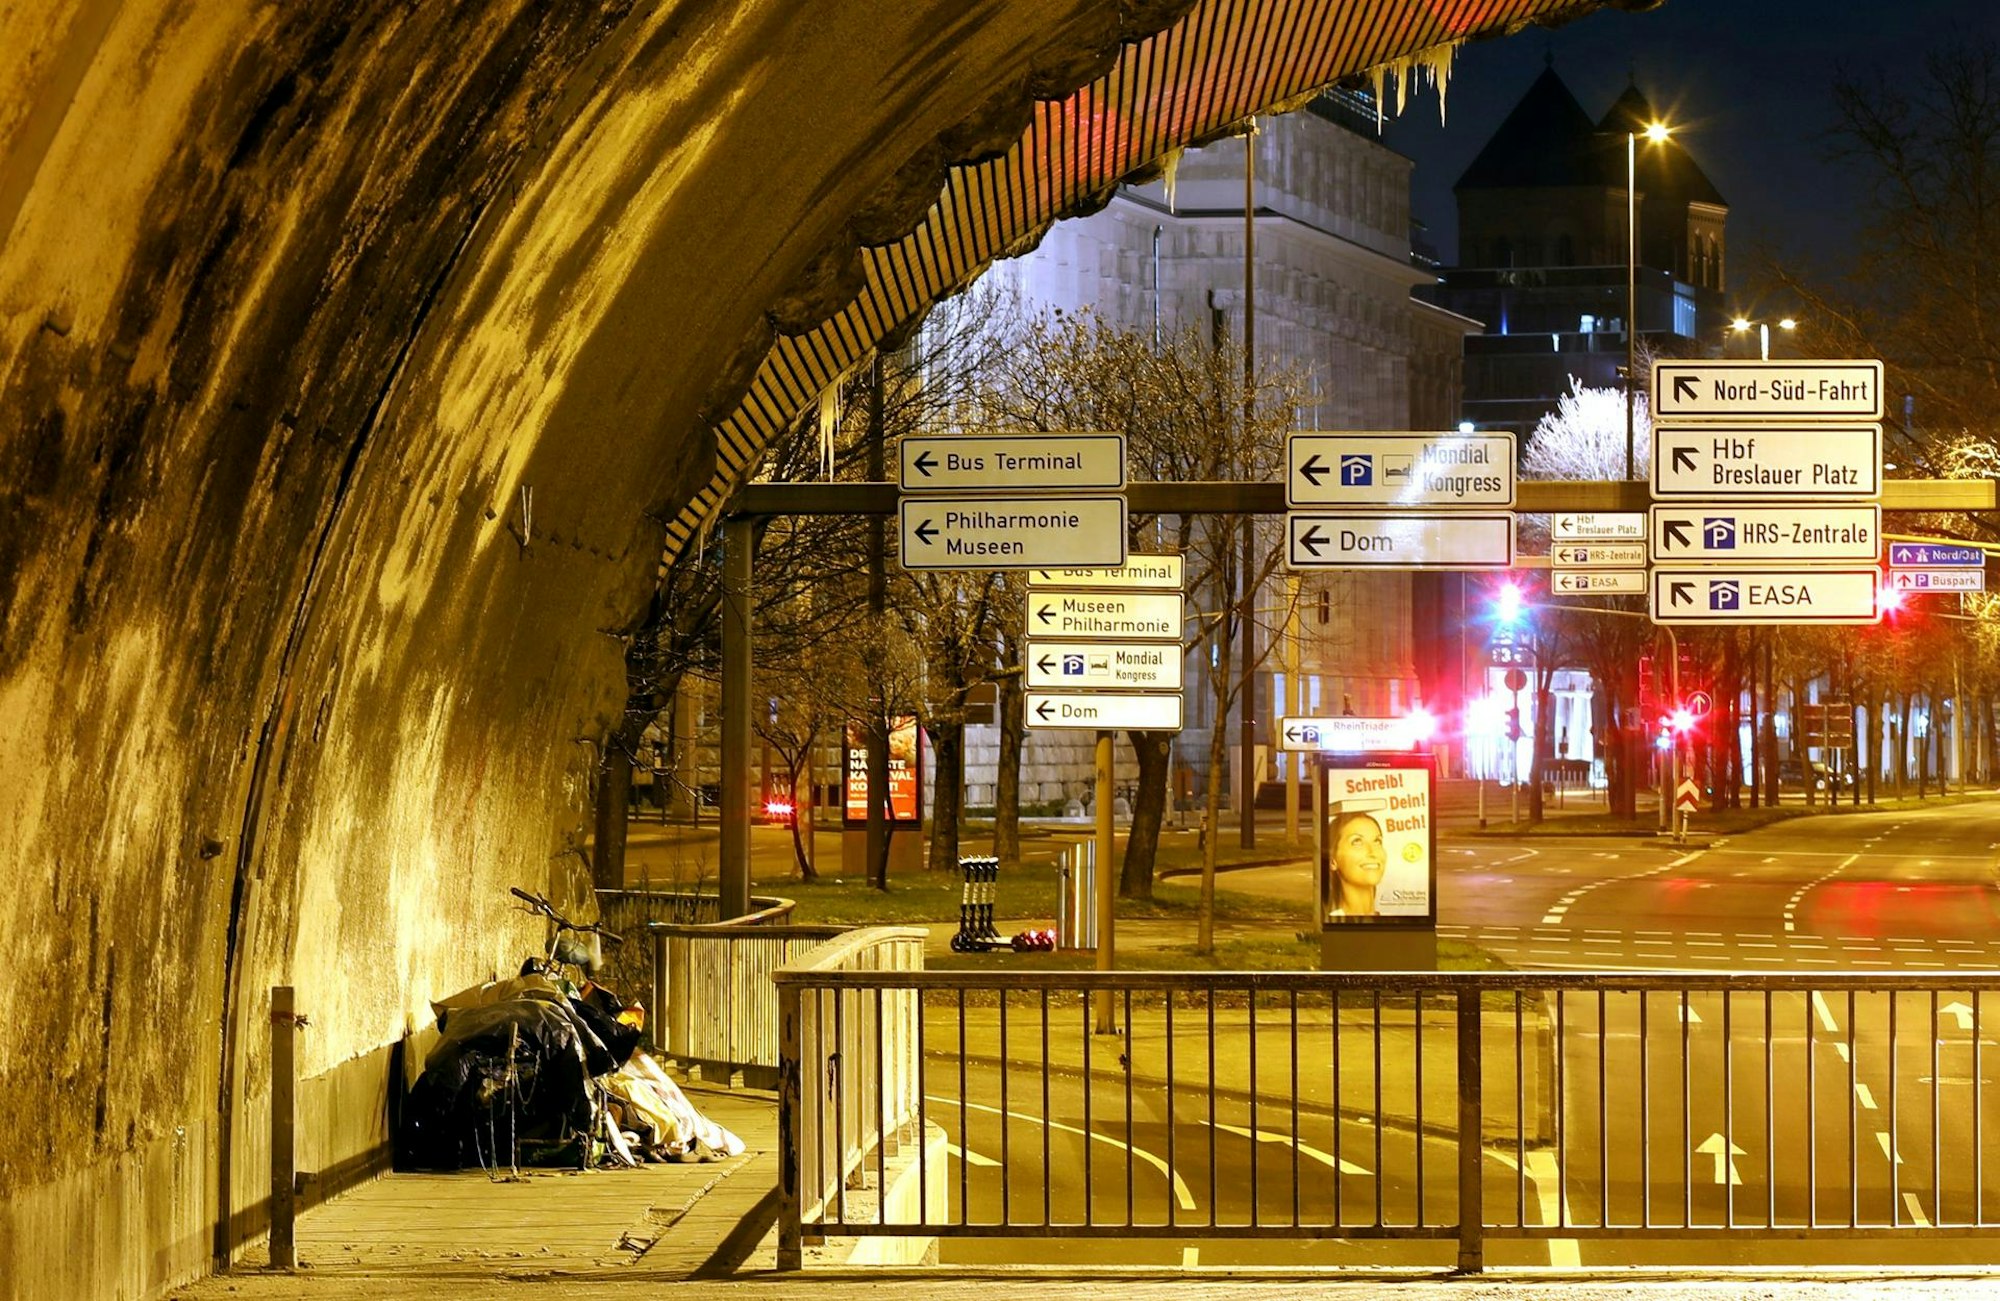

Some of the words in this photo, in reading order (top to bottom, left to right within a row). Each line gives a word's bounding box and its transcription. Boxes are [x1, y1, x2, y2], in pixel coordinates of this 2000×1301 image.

[1714, 379, 1868, 401] Nord-Süd-Fahrt
[1713, 438, 1756, 460] Hbf
[947, 453, 985, 471] Bus
[995, 452, 1083, 470] Terminal
[1350, 465, 1365, 485] P
[1422, 443, 1490, 465] Mondial
[1713, 463, 1802, 485] Breslauer
[1812, 463, 1858, 485] Platz
[1422, 472, 1502, 498] Kongress
[946, 511, 1080, 529] Philharmonie
[1577, 515, 1595, 524] Hbf
[1577, 525, 1614, 534] Breslauer
[1618, 525, 1637, 534] Platz
[1713, 530, 1728, 547] P
[1743, 522, 1868, 544] HRS-Zentrale
[946, 538, 1024, 555] Museen
[1340, 530, 1394, 552] Dom
[1590, 550, 1642, 560] HRS-Zentrale
[1592, 577, 1619, 587] EASA
[1932, 575, 1977, 587] Buspark
[1063, 598, 1126, 613] Museen
[1718, 591, 1733, 609] P
[1749, 586, 1812, 605] EASA
[1062, 617, 1170, 633] Philharmonie
[1068, 660, 1080, 675] P
[1115, 650, 1163, 666] Mondial
[1115, 669, 1158, 683] Kongress
[1062, 704, 1098, 719] Dom
[1346, 773, 1404, 794] Schreib!
[1389, 793, 1426, 811] Dein!
[1385, 814, 1427, 834] Buch!
